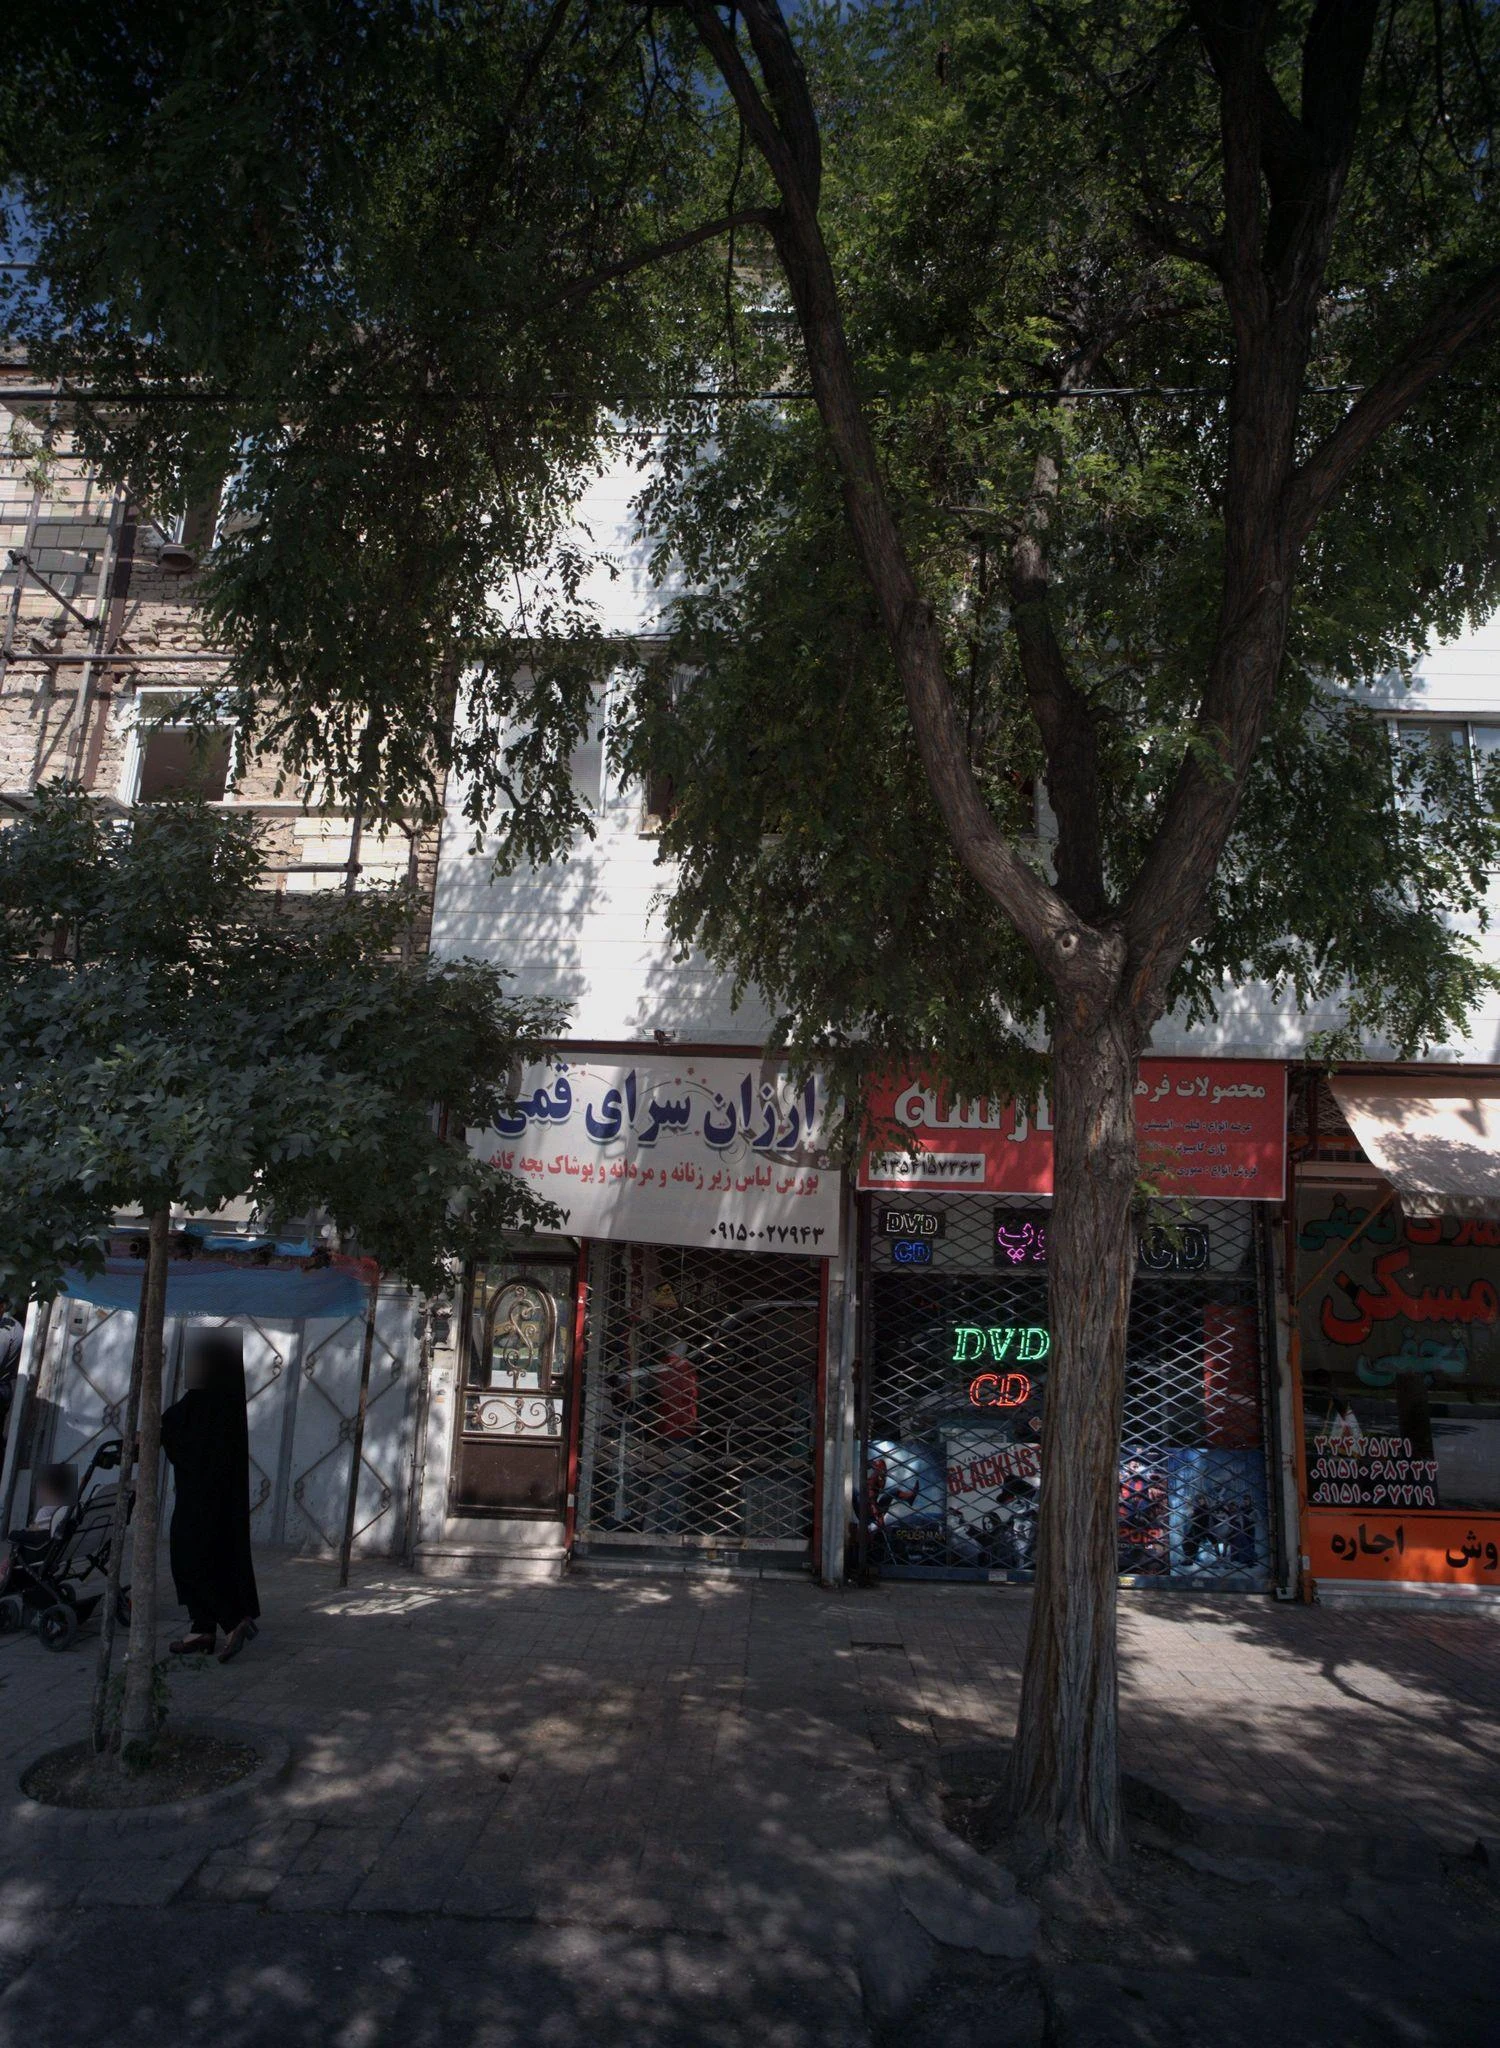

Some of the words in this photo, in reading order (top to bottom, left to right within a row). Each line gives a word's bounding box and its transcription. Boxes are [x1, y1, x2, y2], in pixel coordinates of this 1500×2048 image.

[1176, 1075, 1266, 1104] محصولات
[585, 1068, 691, 1142] سرای
[704, 1073, 816, 1148] ارزان
[489, 1149, 516, 1171] گانه
[547, 1154, 595, 1184] پوشاک
[609, 1154, 655, 1187] مردانه
[873, 1158, 982, 1177] ۹۳۵۴۱۵۷۳۶۳
[598, 1164, 607, 1184] و
[658, 1168, 668, 1188] و
[672, 1161, 705, 1190] زنانه
[708, 1168, 732, 1191] زیر
[735, 1165, 773, 1192] لباس
[776, 1173, 820, 1197] بورس
[710, 1220, 825, 1246] ۰۹۱۵۰۰۲۷۹۴۳
[885, 1211, 938, 1235] DVD
[893, 1239, 932, 1264] CD
[1320, 1246, 1498, 1346] مسکن
[952, 1327, 1051, 1361] DVD
[1355, 1325, 1469, 1389] نجفی
[969, 1373, 1032, 1407] CD
[1313, 1435, 1412, 1458] ۳۳۴۲۵۱۳۱
[1310, 1458, 1439, 1482] ۰۹۱۵۱۰۶۸۴۳۳
[1312, 1482, 1436, 1506] ۰۹۱۵۱۰۶۷۲۱۹
[1330, 1523, 1404, 1562] اجاره
[1444, 1529, 1499, 1570] وش
